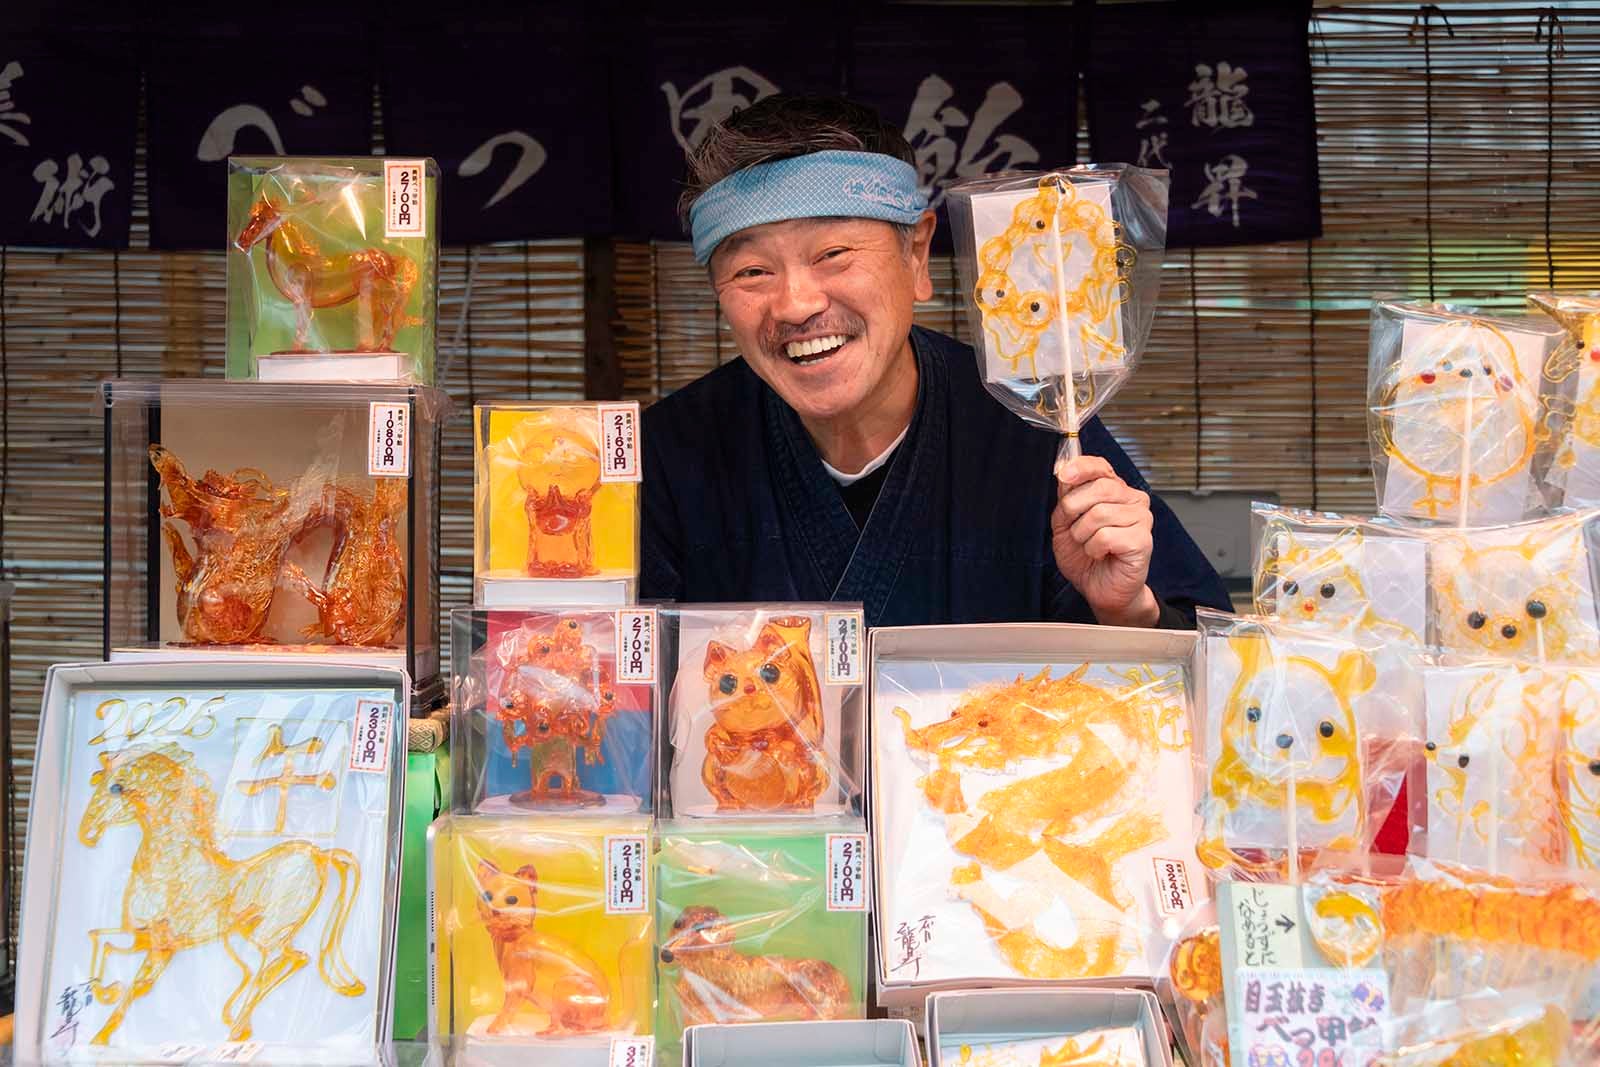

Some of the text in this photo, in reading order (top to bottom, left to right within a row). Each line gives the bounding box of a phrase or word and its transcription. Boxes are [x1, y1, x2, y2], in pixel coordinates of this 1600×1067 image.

[399, 171, 411, 225] 2700円
[383, 409, 395, 467] 10800円
[613, 414, 626, 470] 2160円
[630, 616, 643, 674] 2700円
[837, 618, 851, 677] 2700円
[361, 706, 380, 764] 2300円
[620, 844, 634, 903] 2160円
[840, 842, 854, 902] 2700円
[1165, 863, 1185, 910] 3240円
[1245, 978, 1326, 1015] 目玉抜き
